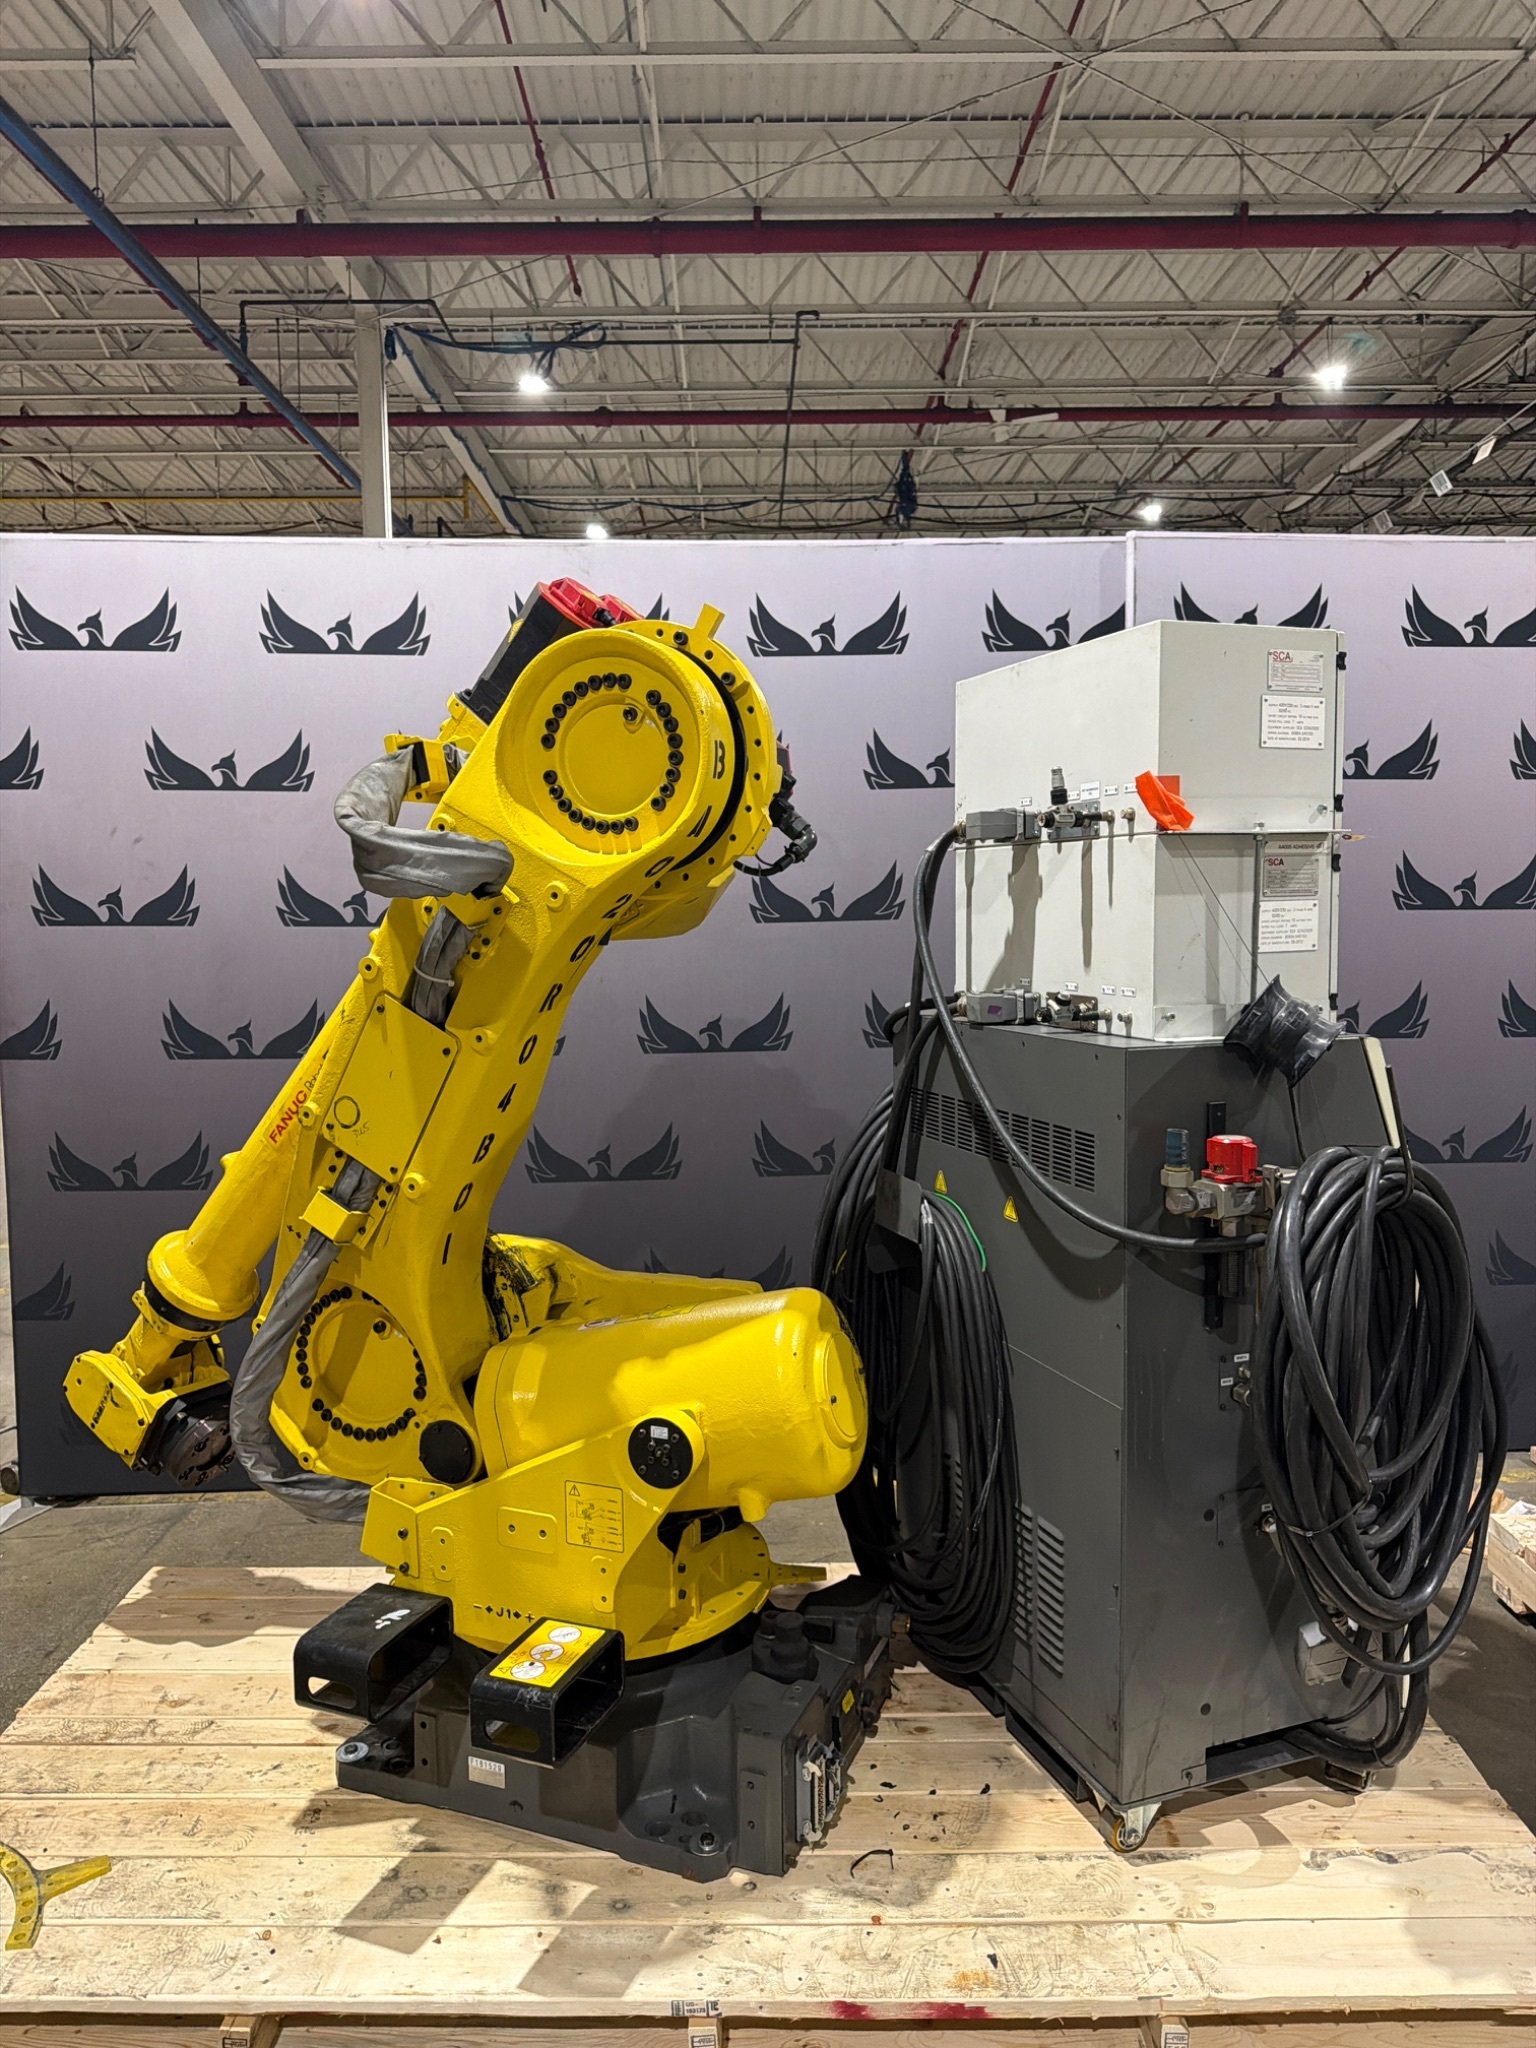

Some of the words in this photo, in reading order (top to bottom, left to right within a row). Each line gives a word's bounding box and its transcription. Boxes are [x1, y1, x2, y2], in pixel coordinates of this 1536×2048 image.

[1272, 651, 1291, 661] SCA
[1268, 858, 1285, 866] SCA
[269, 1090, 307, 1144] FANUC
[496, 1606, 511, 1620] J1
